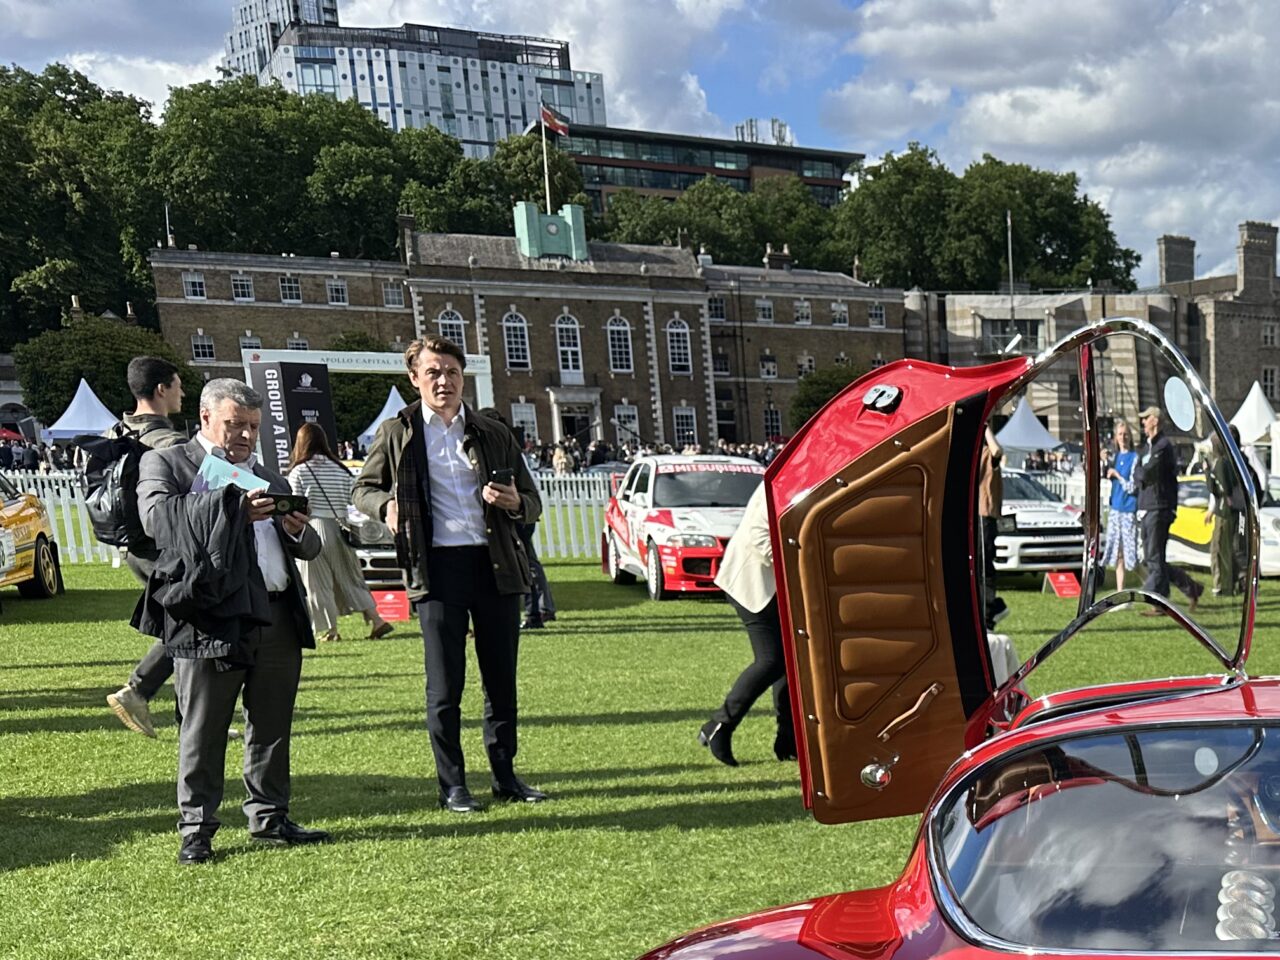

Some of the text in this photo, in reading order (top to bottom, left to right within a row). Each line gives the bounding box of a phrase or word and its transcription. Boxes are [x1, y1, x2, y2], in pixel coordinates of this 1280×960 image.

[265, 369, 291, 475] GROUP A RALL
[673, 464, 753, 473] MITSUBISHI
